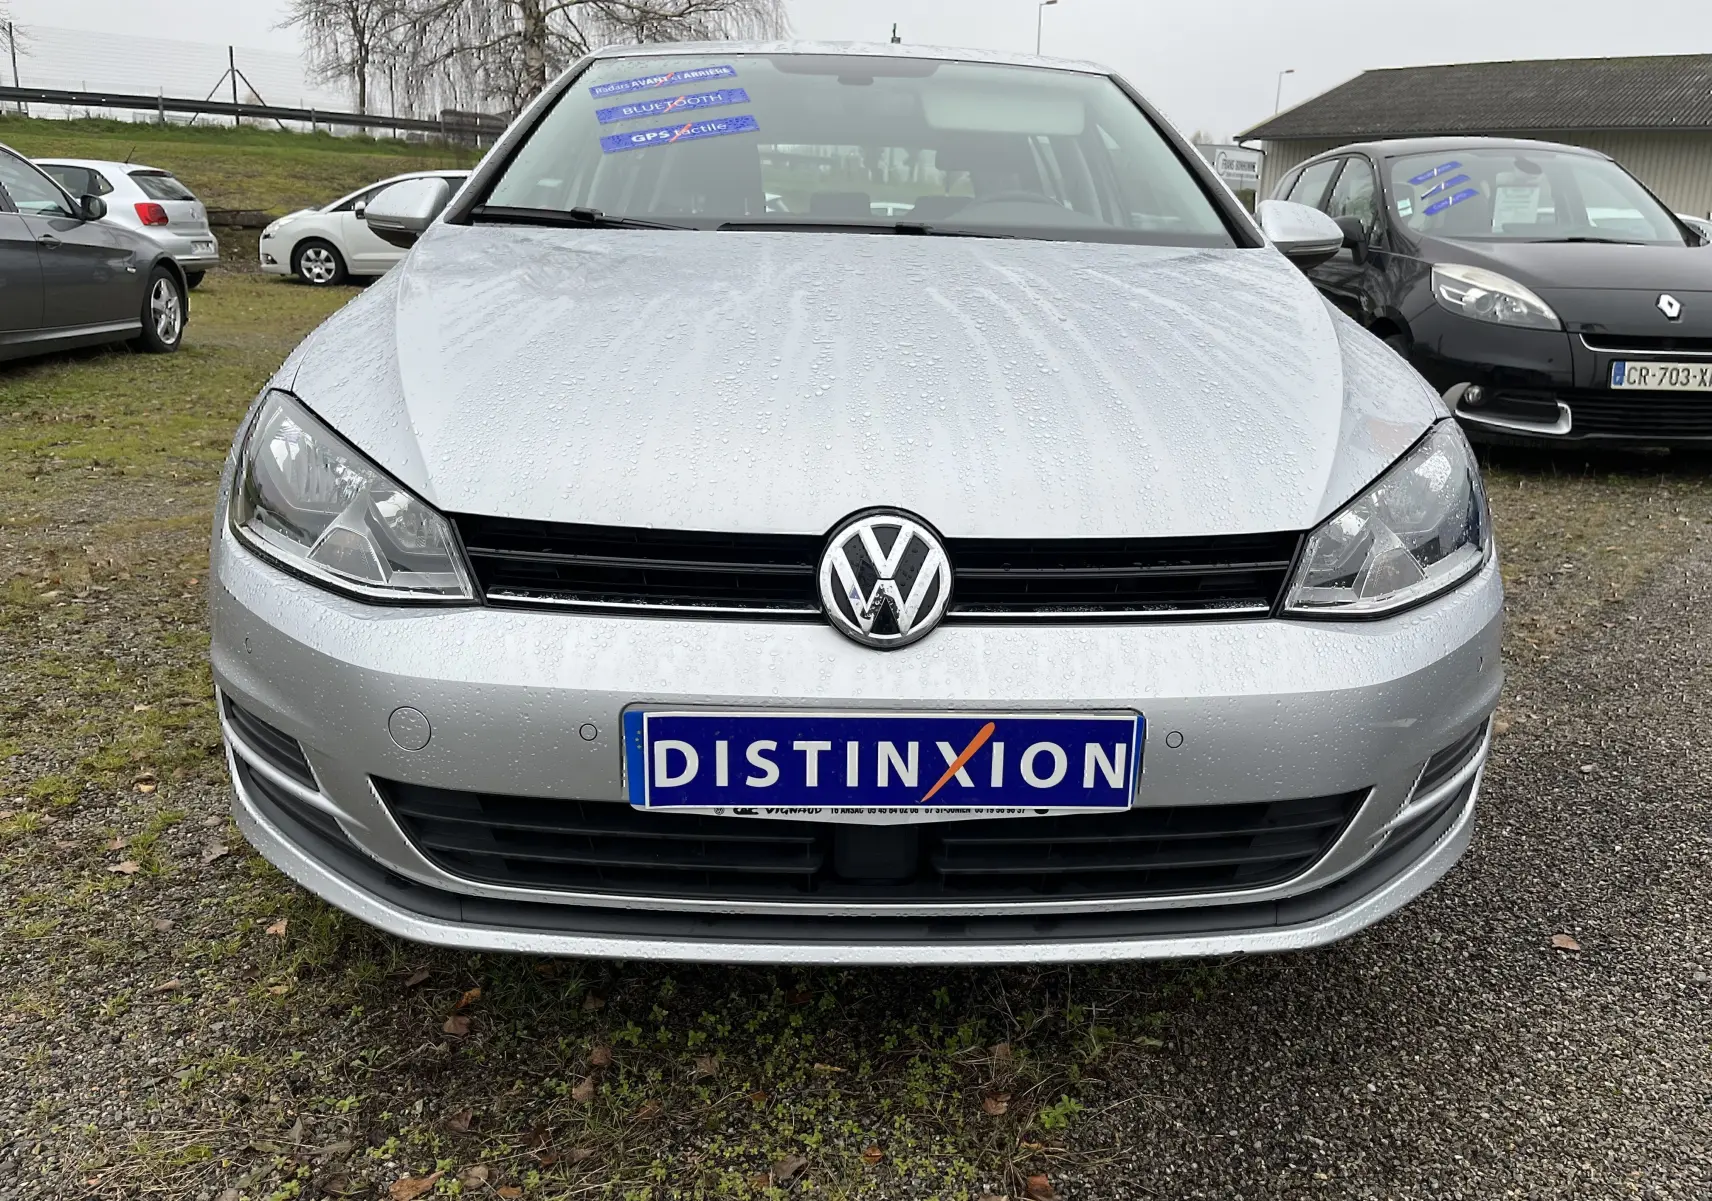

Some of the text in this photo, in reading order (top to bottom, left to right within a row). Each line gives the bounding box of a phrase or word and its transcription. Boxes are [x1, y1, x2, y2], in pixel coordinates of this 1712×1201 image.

[595, 83, 630, 94] Radars
[631, 76, 669, 87] AVANT
[622, 94, 723, 115] BLUETOOTH
[631, 123, 727, 143] GPS tactile
[654, 722, 1127, 803] DISTINXION
